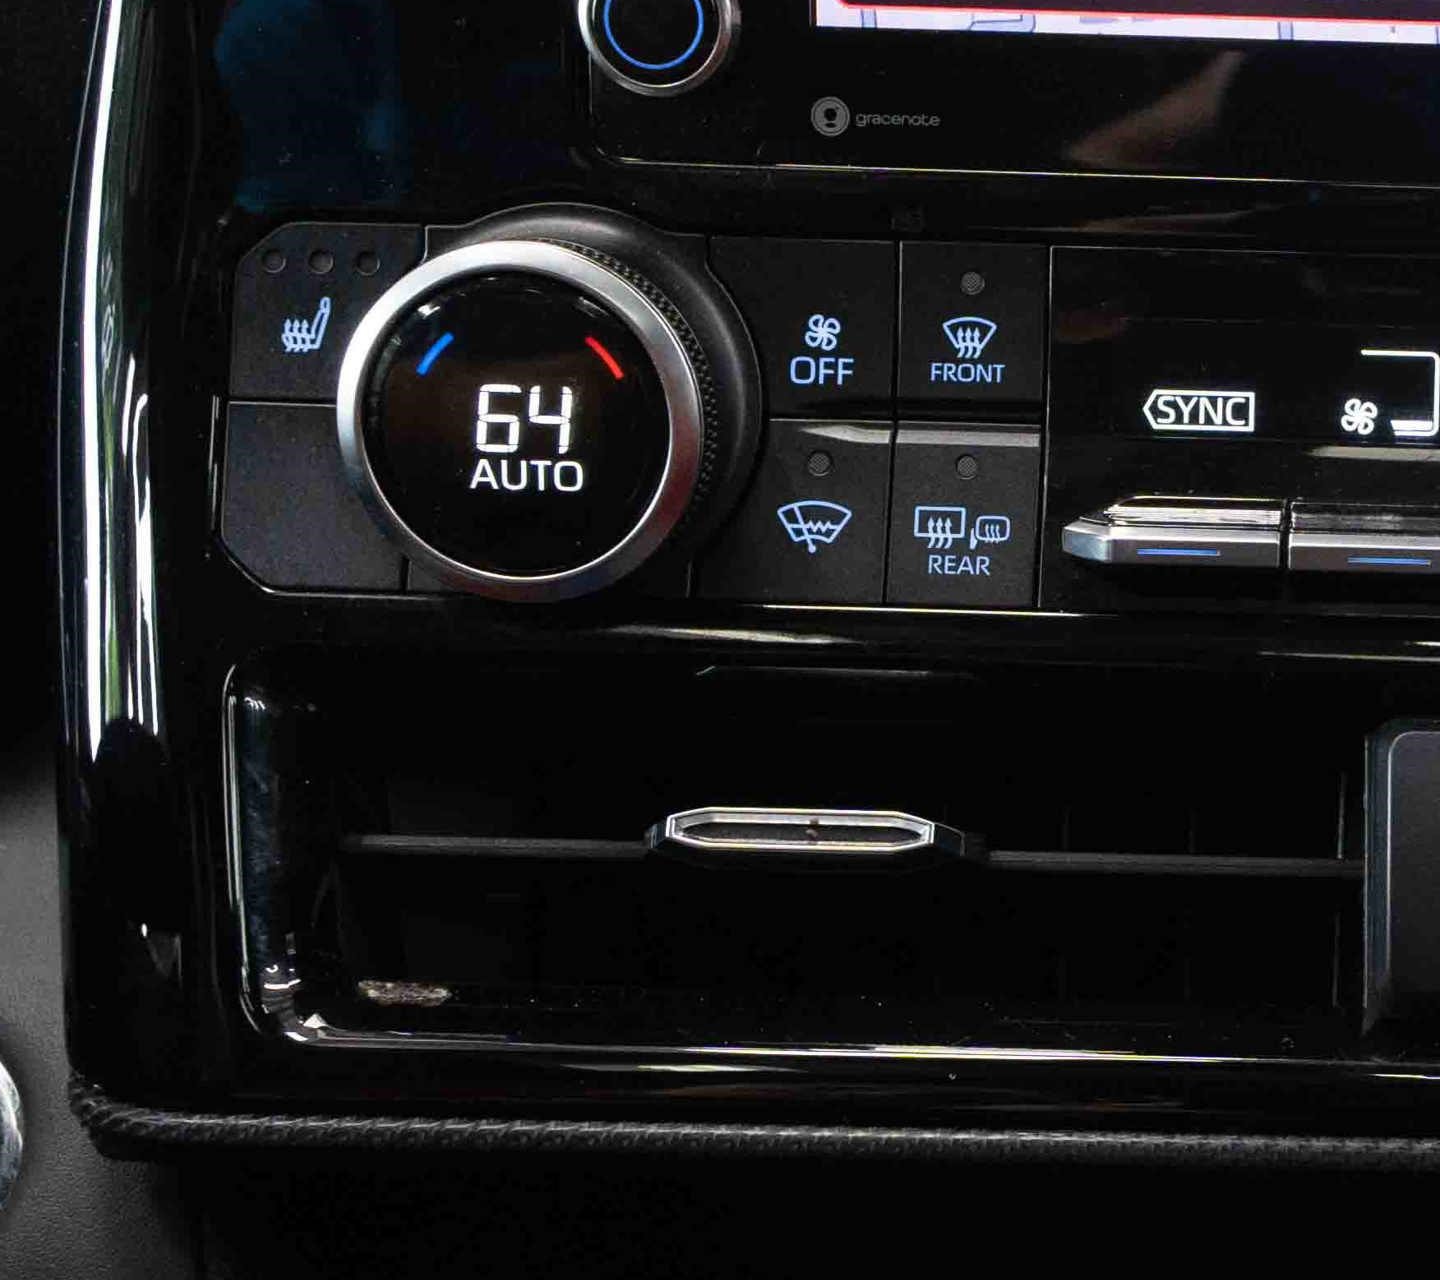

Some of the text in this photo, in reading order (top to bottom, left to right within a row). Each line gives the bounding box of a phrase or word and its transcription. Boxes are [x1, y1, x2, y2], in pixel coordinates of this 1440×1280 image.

[855, 113, 941, 128] gracenote
[789, 356, 854, 385] OFF
[930, 362, 1006, 383] FRONT
[475, 383, 574, 455] 64
[1156, 394, 1250, 427] SYNC
[469, 458, 584, 492] AUTO
[928, 554, 990, 576] REAR
